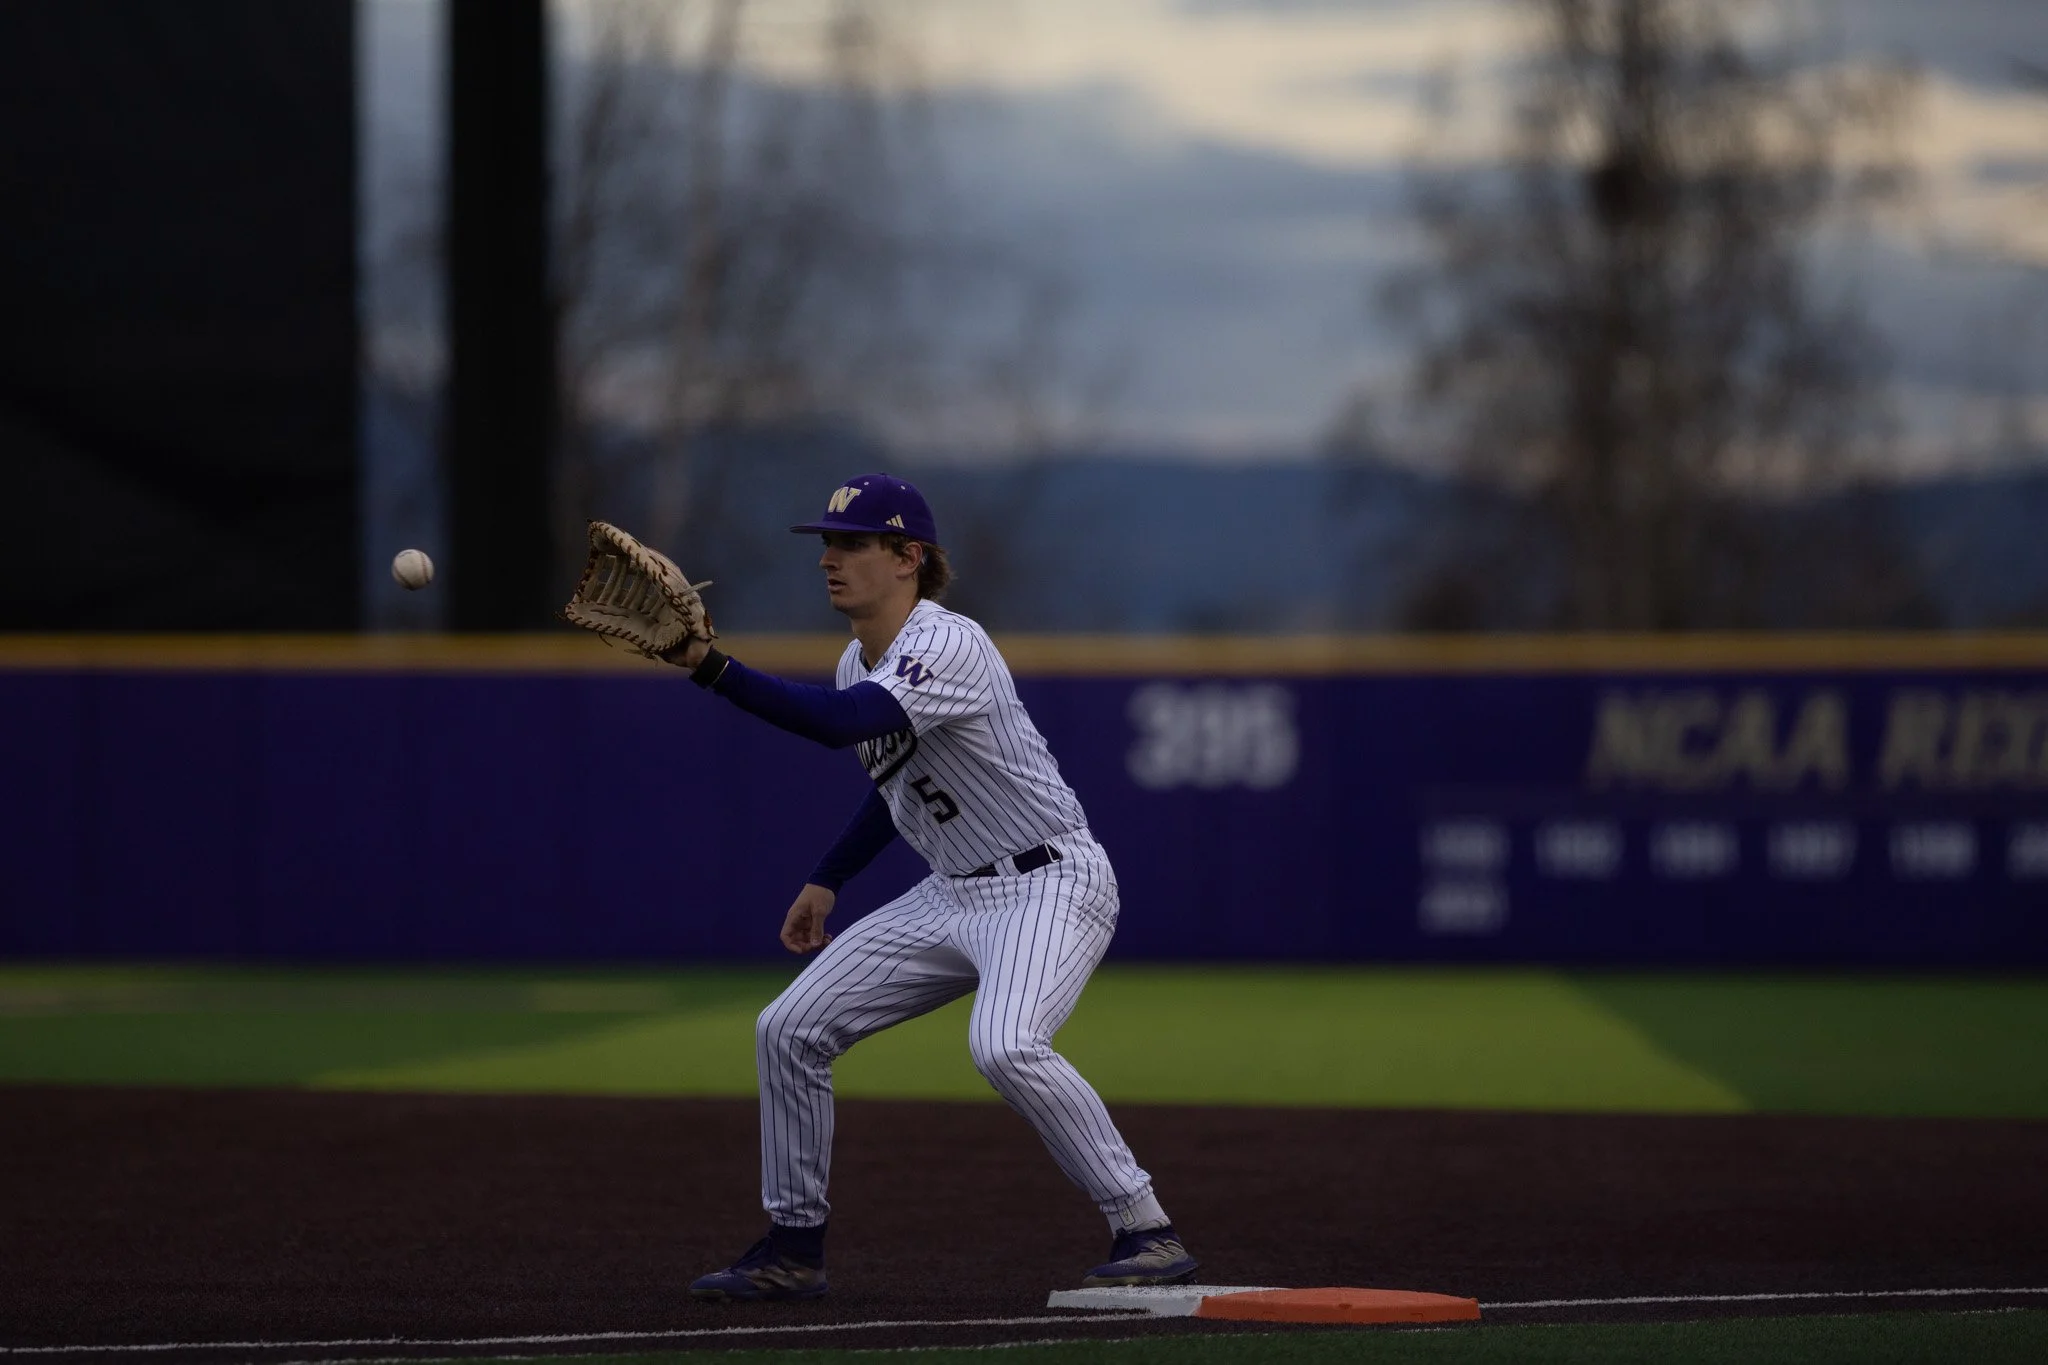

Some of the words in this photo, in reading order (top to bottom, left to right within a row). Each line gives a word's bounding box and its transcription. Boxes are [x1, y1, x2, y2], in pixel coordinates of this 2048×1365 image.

[828, 486, 862, 513] W
[895, 655, 933, 687] W
[1127, 684, 1299, 791] 395
[1587, 688, 1850, 792] NCAA
[911, 775, 961, 824] 5
